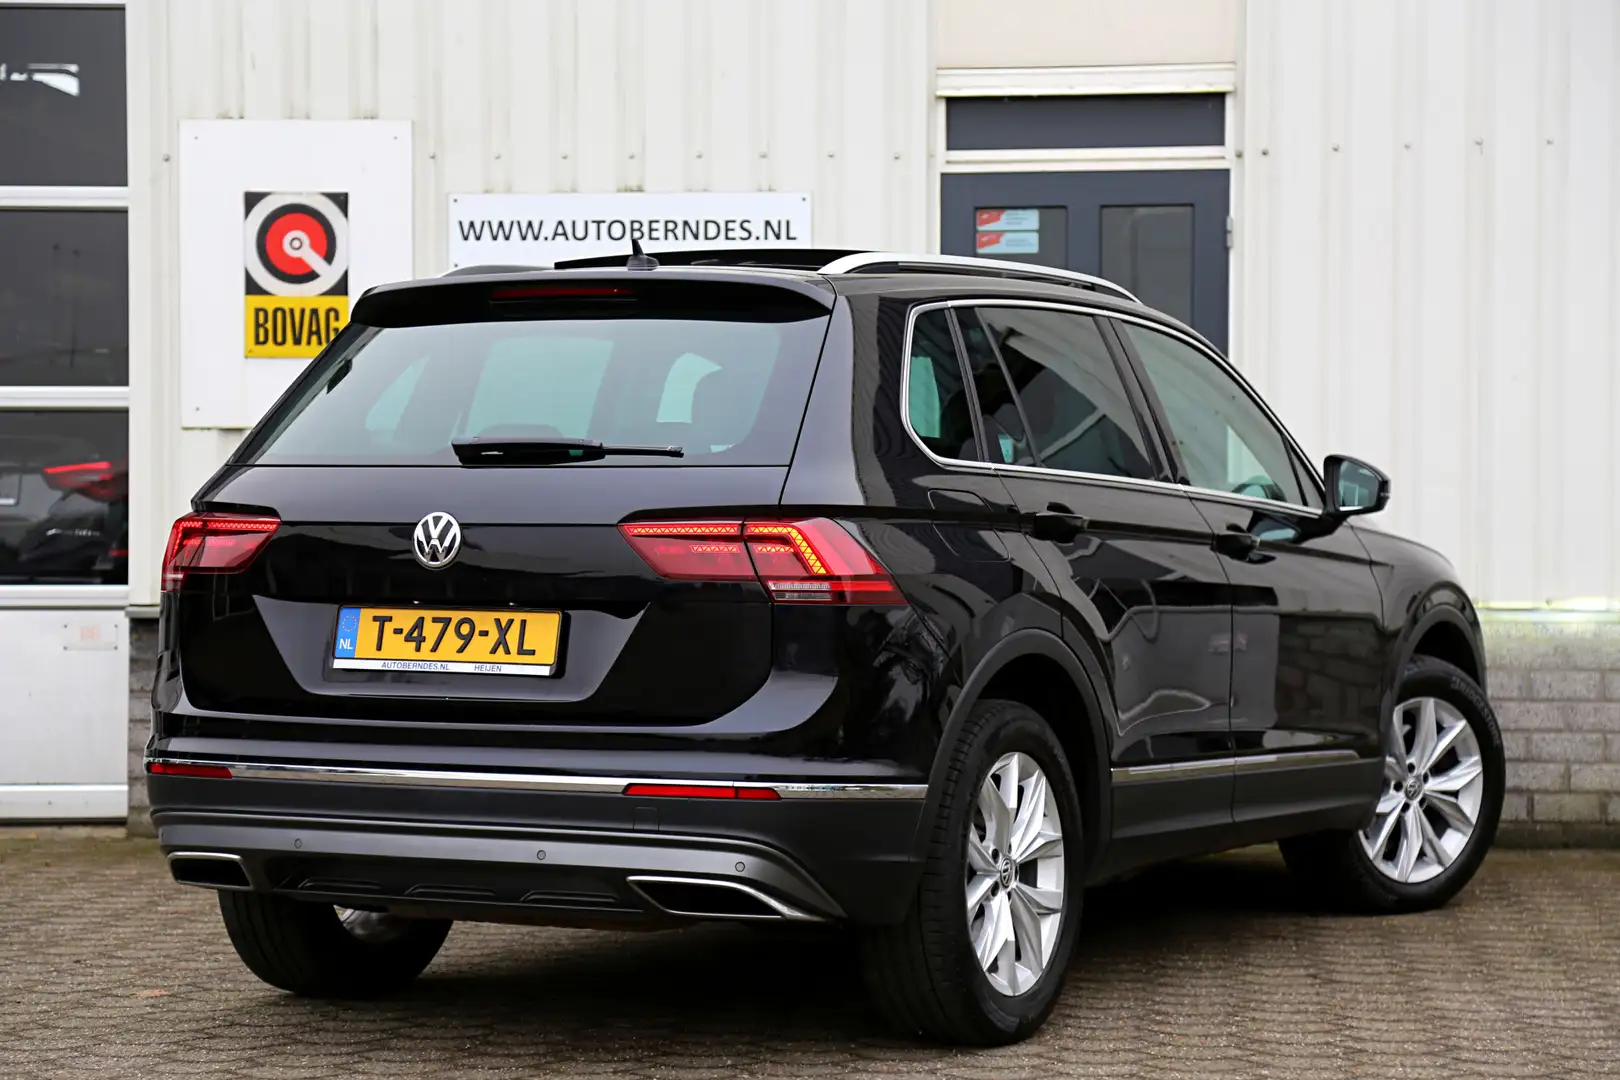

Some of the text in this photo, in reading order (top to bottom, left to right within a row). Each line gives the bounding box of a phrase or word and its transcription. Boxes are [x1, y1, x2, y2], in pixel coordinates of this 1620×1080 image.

[458, 219, 798, 242] WWW.AUTOBERNDES.NL
[253, 306, 341, 346] BOVAG
[338, 637, 354, 650] NL
[372, 615, 536, 656] T-479-XL
[381, 661, 502, 673] AUTOBERNDES.NL HEIJEN
